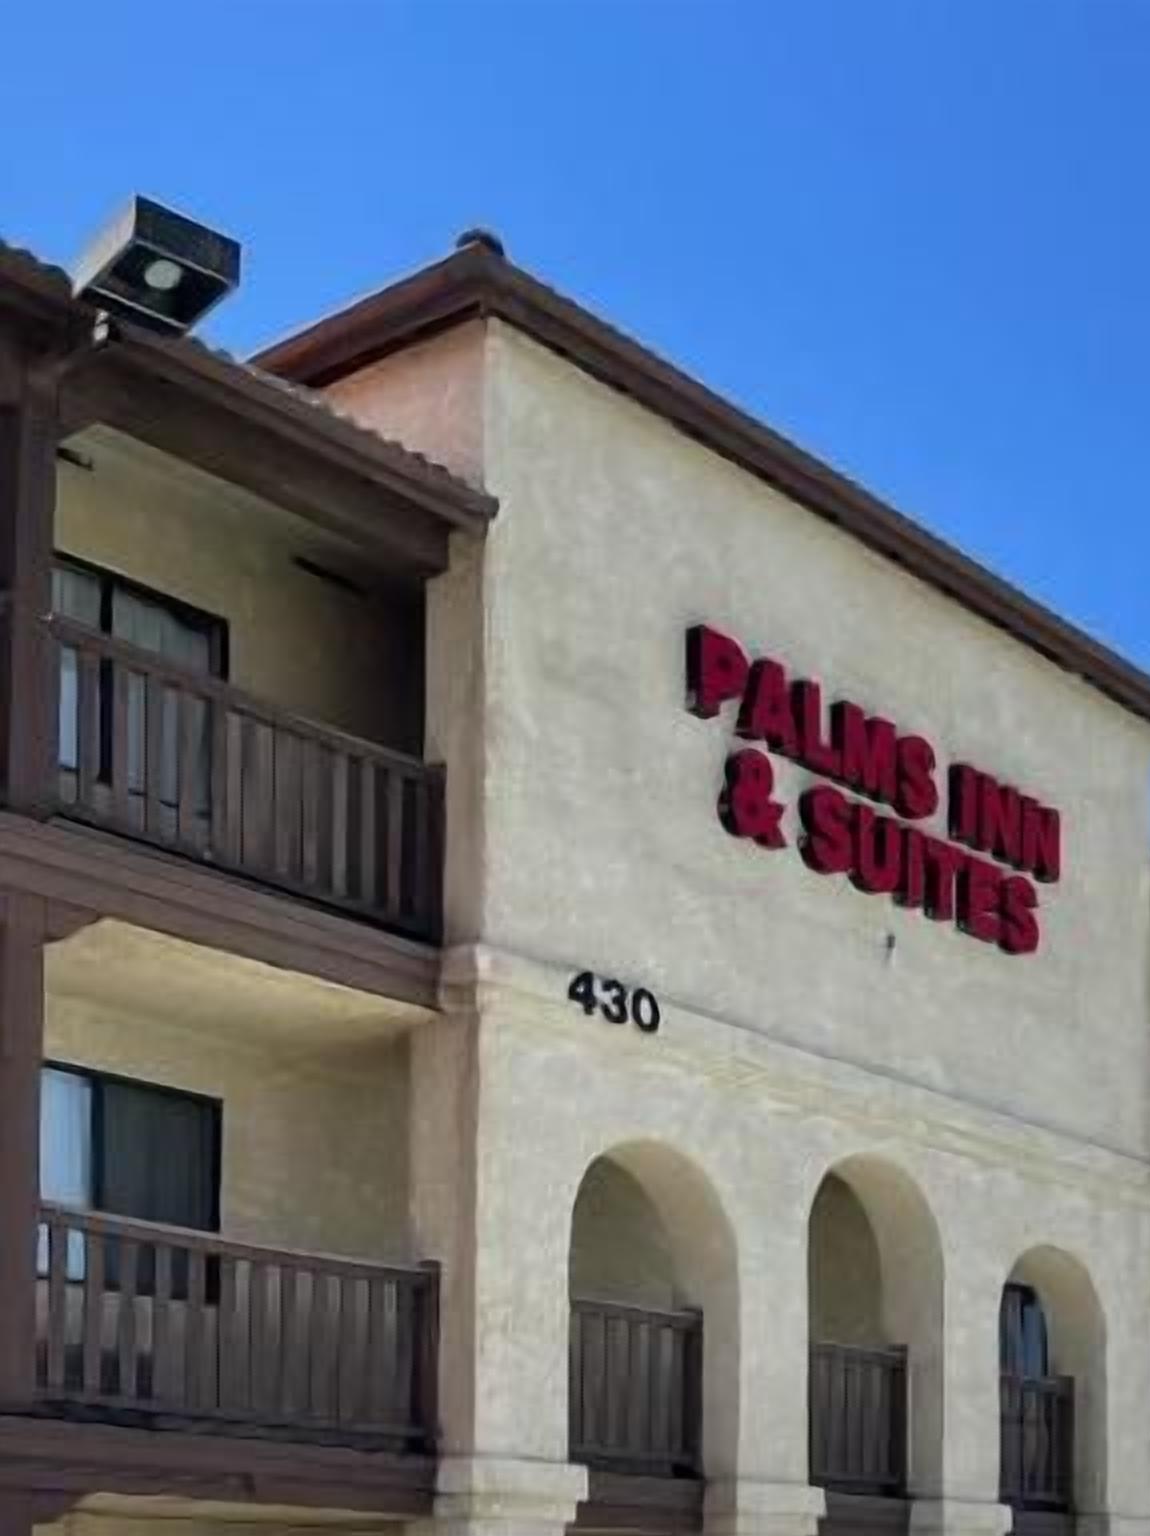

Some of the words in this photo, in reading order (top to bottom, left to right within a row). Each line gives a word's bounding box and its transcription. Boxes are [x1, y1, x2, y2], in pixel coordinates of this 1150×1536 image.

[686, 625, 938, 818] PALMS
[949, 764, 1060, 883] INN
[718, 749, 786, 849] &
[798, 785, 1039, 954] SUITES
[568, 970, 661, 1032] 430
